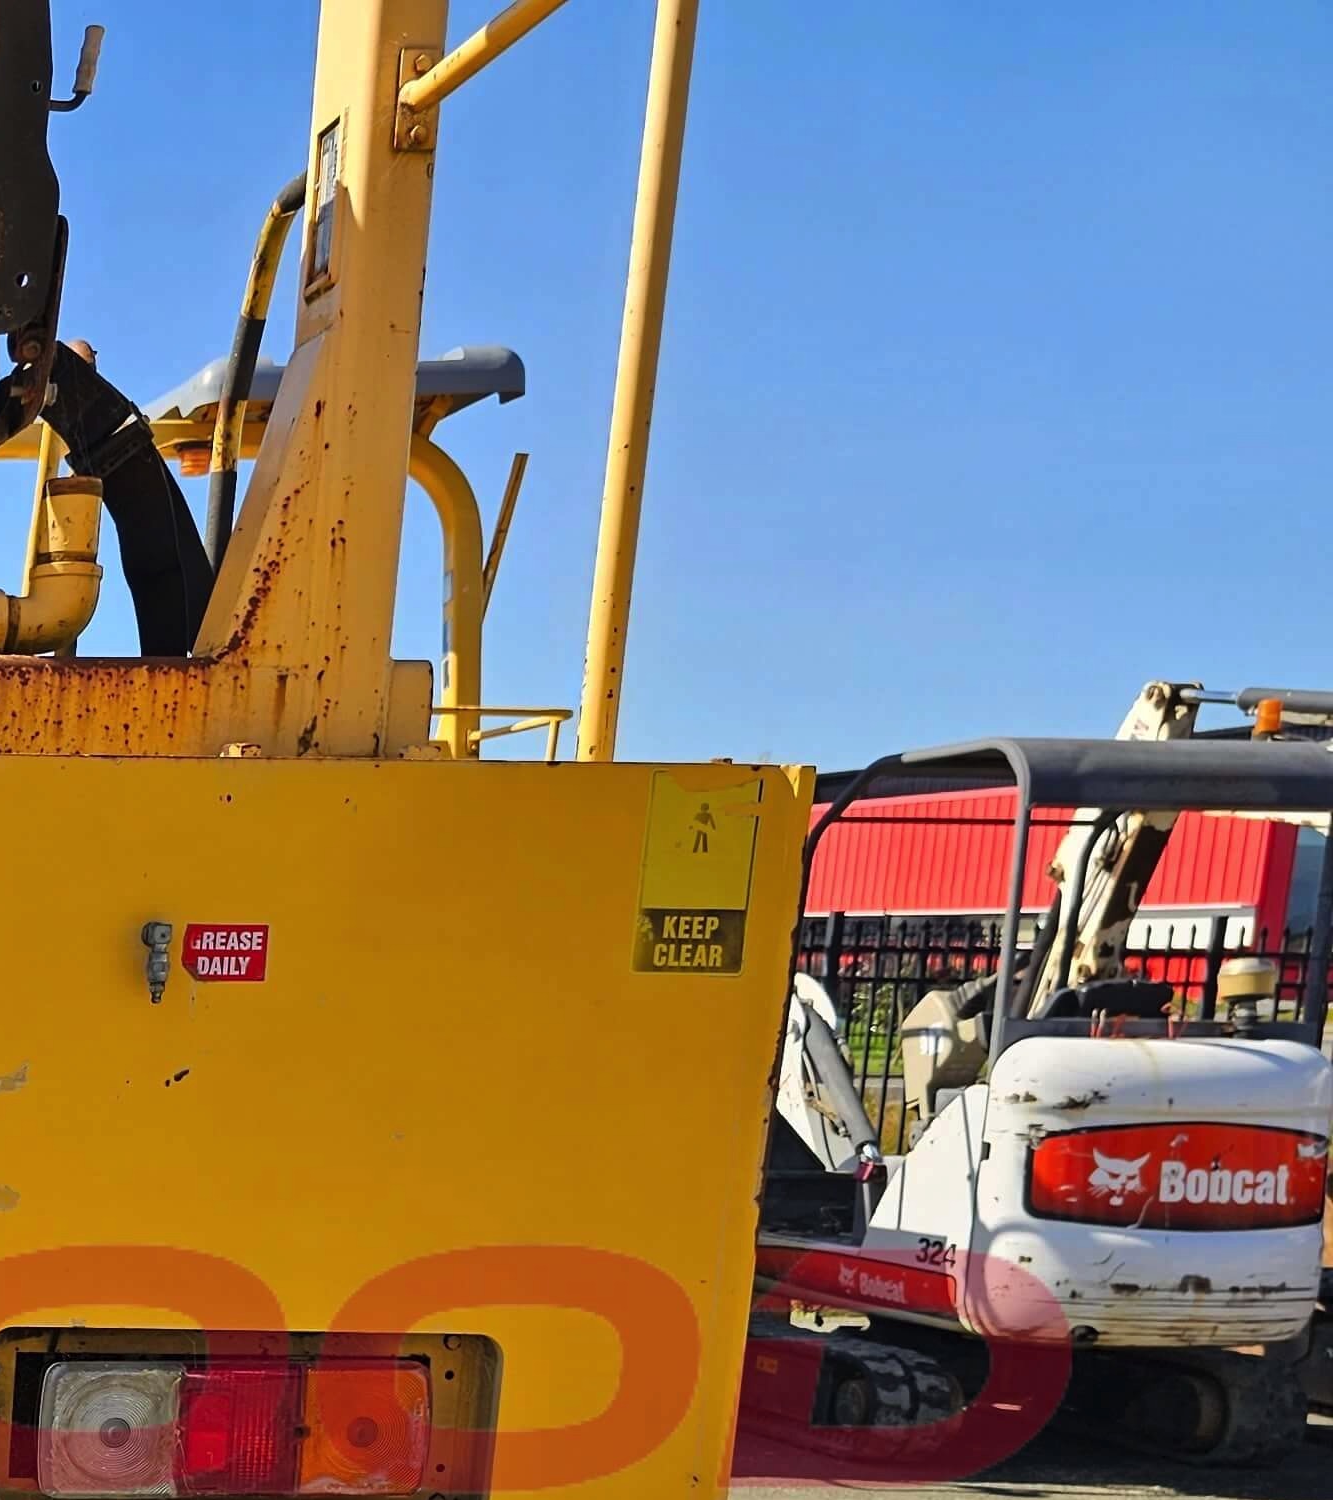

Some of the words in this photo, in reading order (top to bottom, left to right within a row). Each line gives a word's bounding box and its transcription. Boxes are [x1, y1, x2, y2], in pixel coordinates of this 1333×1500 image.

[662, 916, 720, 939] KEEP
[196, 956, 251, 976] DAILY
[653, 943, 723, 967] CLEAR
[1159, 1160, 1290, 1206] Bobcat
[916, 1238, 958, 1268] 324
[859, 1271, 910, 1305] Bobcat
